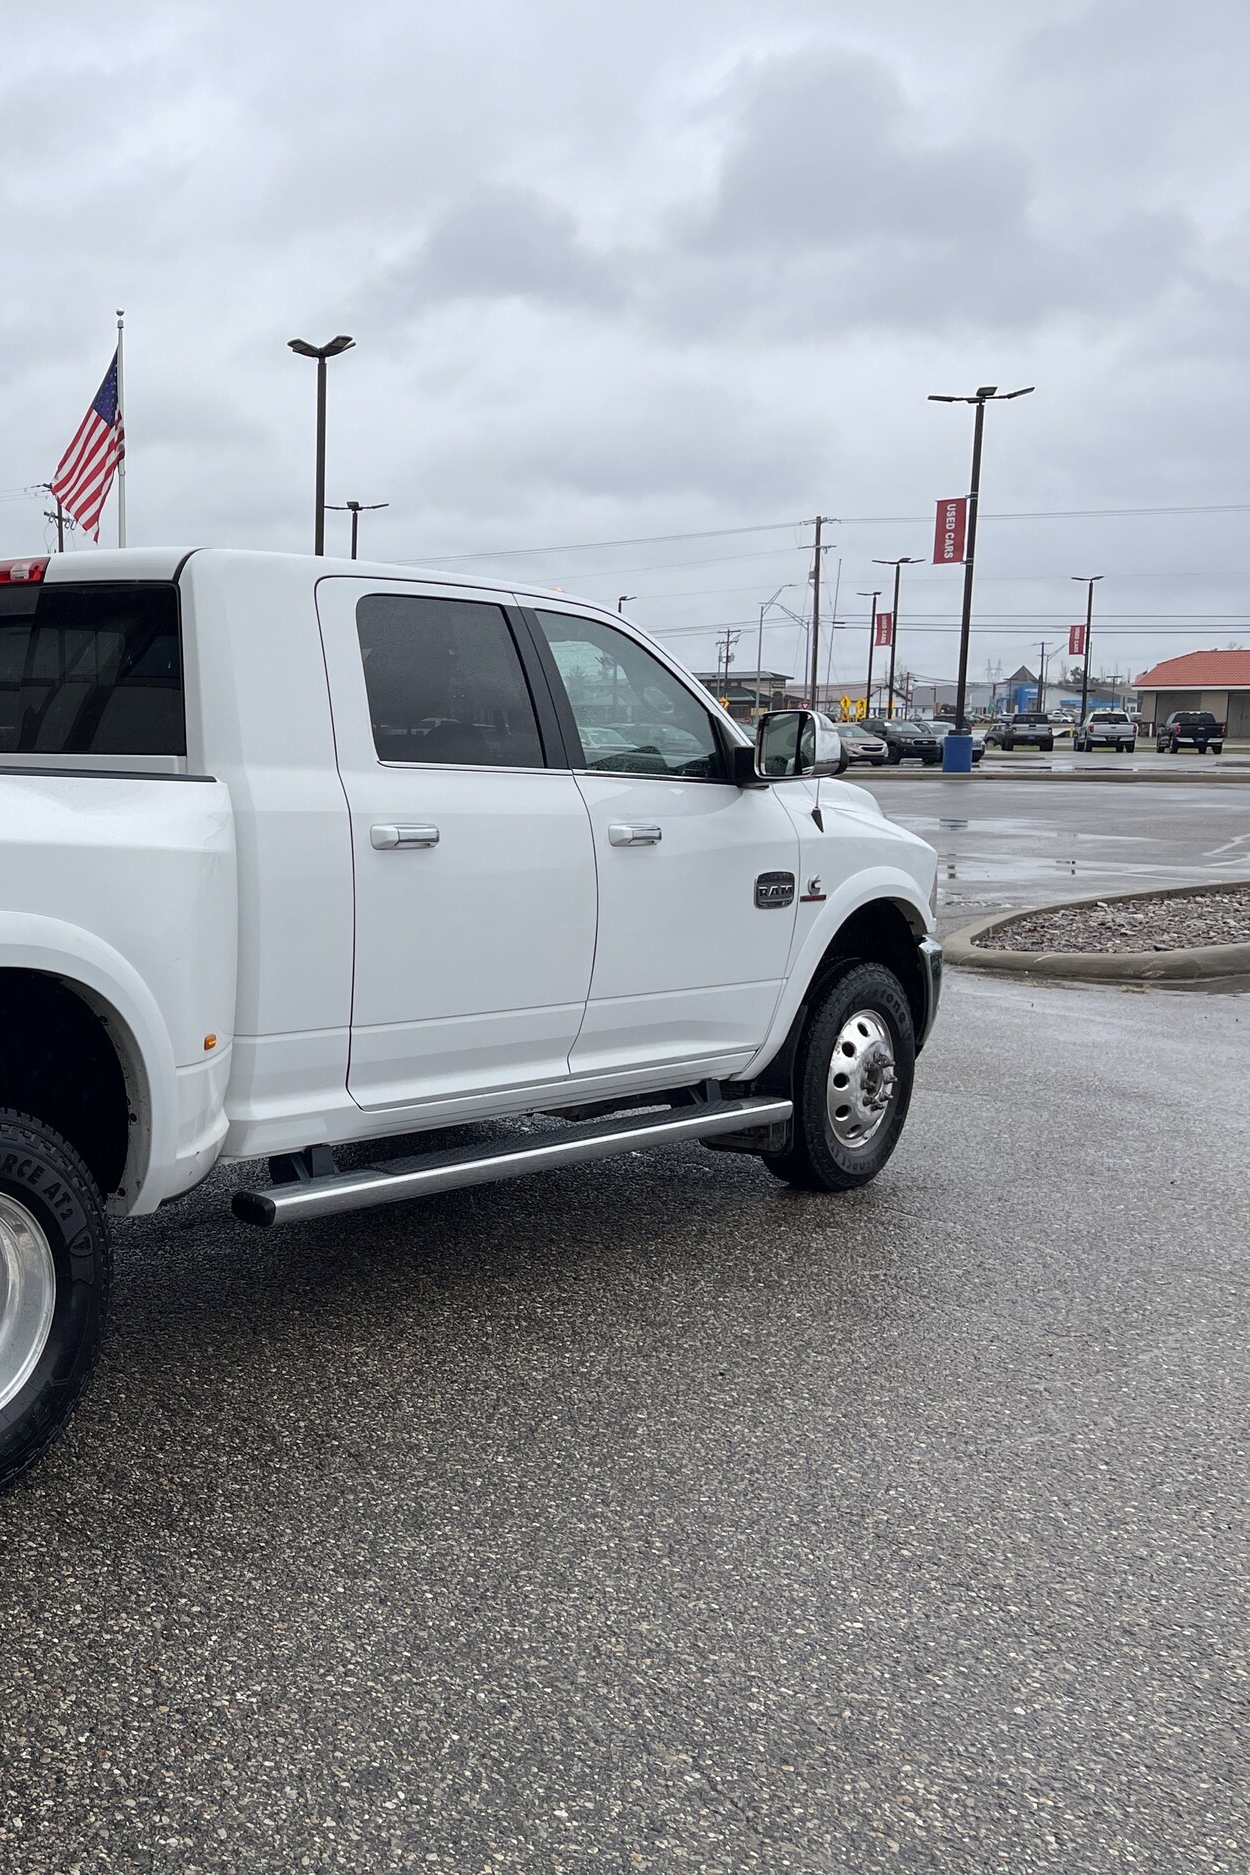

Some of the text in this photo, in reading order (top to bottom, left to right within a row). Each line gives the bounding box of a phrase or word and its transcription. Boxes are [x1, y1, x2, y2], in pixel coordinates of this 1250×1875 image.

[943, 503, 956, 559] USED CARS
[758, 885, 793, 897] RAM
